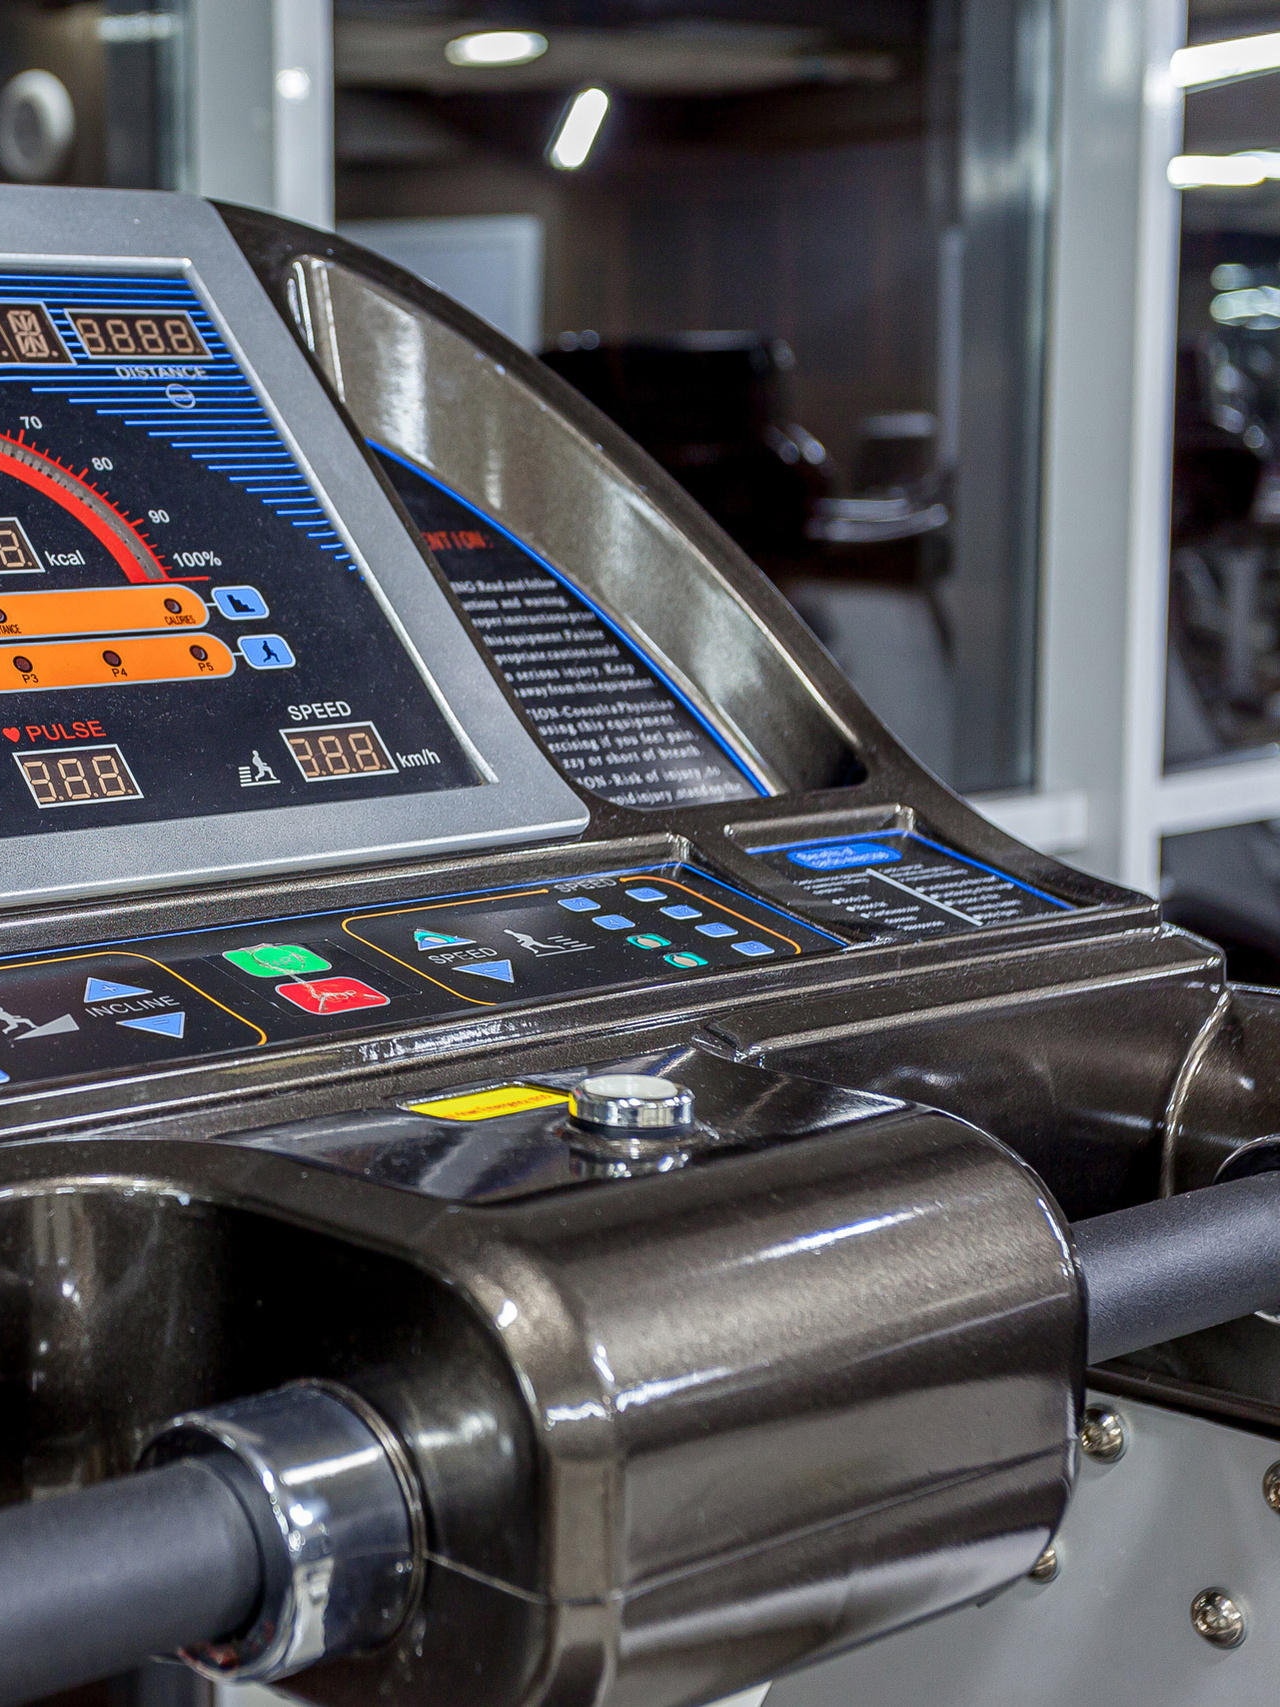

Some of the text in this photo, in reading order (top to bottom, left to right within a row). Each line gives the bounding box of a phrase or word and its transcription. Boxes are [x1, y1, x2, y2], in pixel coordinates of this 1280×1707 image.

[115, 365, 209, 380] DISTANCE
[19, 414, 43, 430] 70
[92, 456, 114, 472] 80
[148, 508, 171, 525] 90
[45, 549, 86, 567] kcal
[172, 550, 222, 568] 100%
[164, 614, 197, 626] CALORIES
[111, 666, 129, 678] P4
[197, 661, 215, 673] P5
[21, 672, 40, 685] P3
[287, 702, 352, 722] SPEED
[25, 719, 107, 743] PULSE
[396, 748, 442, 770] km/h
[554, 877, 617, 893] SPEED
[428, 947, 498, 965] SPEED
[85, 995, 180, 1018] INCLINE
